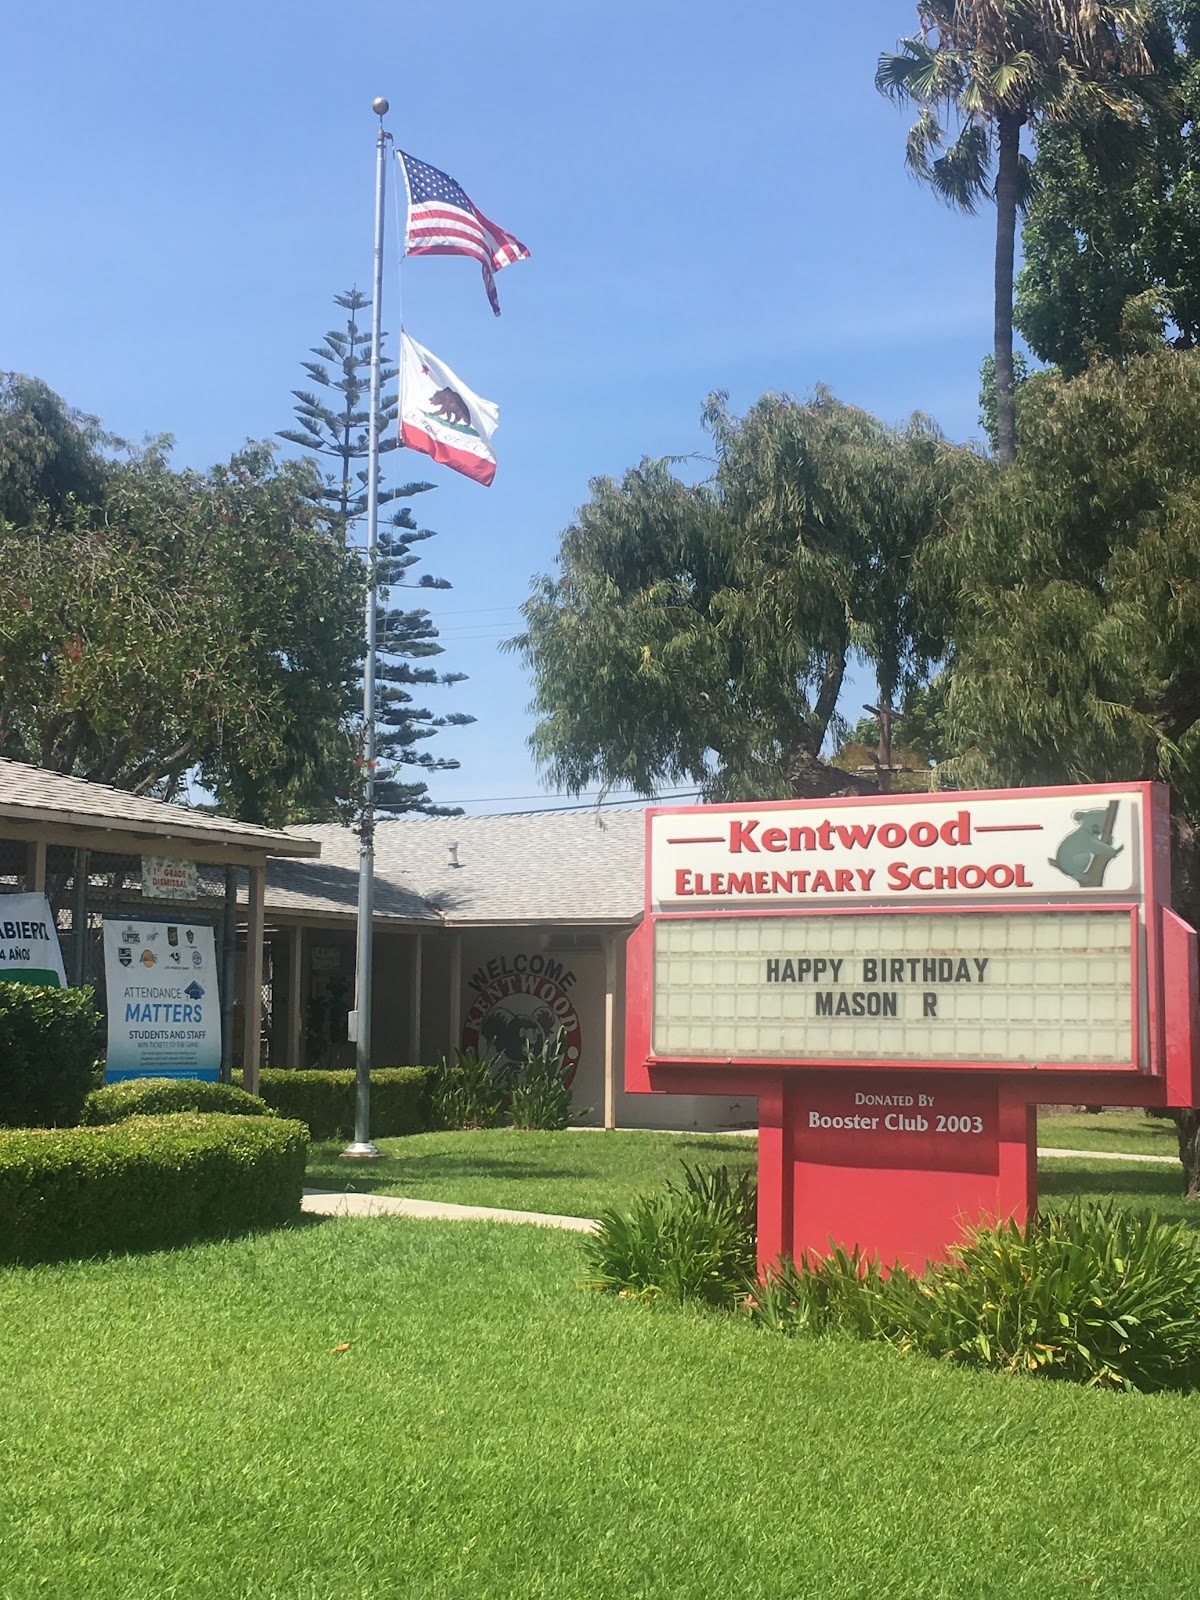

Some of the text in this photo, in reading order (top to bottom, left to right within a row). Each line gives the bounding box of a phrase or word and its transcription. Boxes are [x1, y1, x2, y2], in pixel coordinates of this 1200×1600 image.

[728, 810, 972, 853] Kentwood
[152, 877, 188, 889] DISMISSAL
[164, 868, 187, 879] GRADE
[674, 862, 1033, 896] ELEMENTARY SCHOOL
[467, 953, 577, 993] WELCOME
[766, 957, 989, 983] HAPPY BIRTHDAY
[124, 986, 182, 999] ATTENDANCE
[465, 974, 578, 1032] KENTWOOD
[815, 991, 938, 1017] MASON R
[125, 1003, 203, 1023] MATTERS
[128, 1030, 206, 1039] STUDENTS AND STAFF
[855, 1092, 935, 1107] DONATED BY
[808, 1111, 983, 1134] Booster Club 2003
